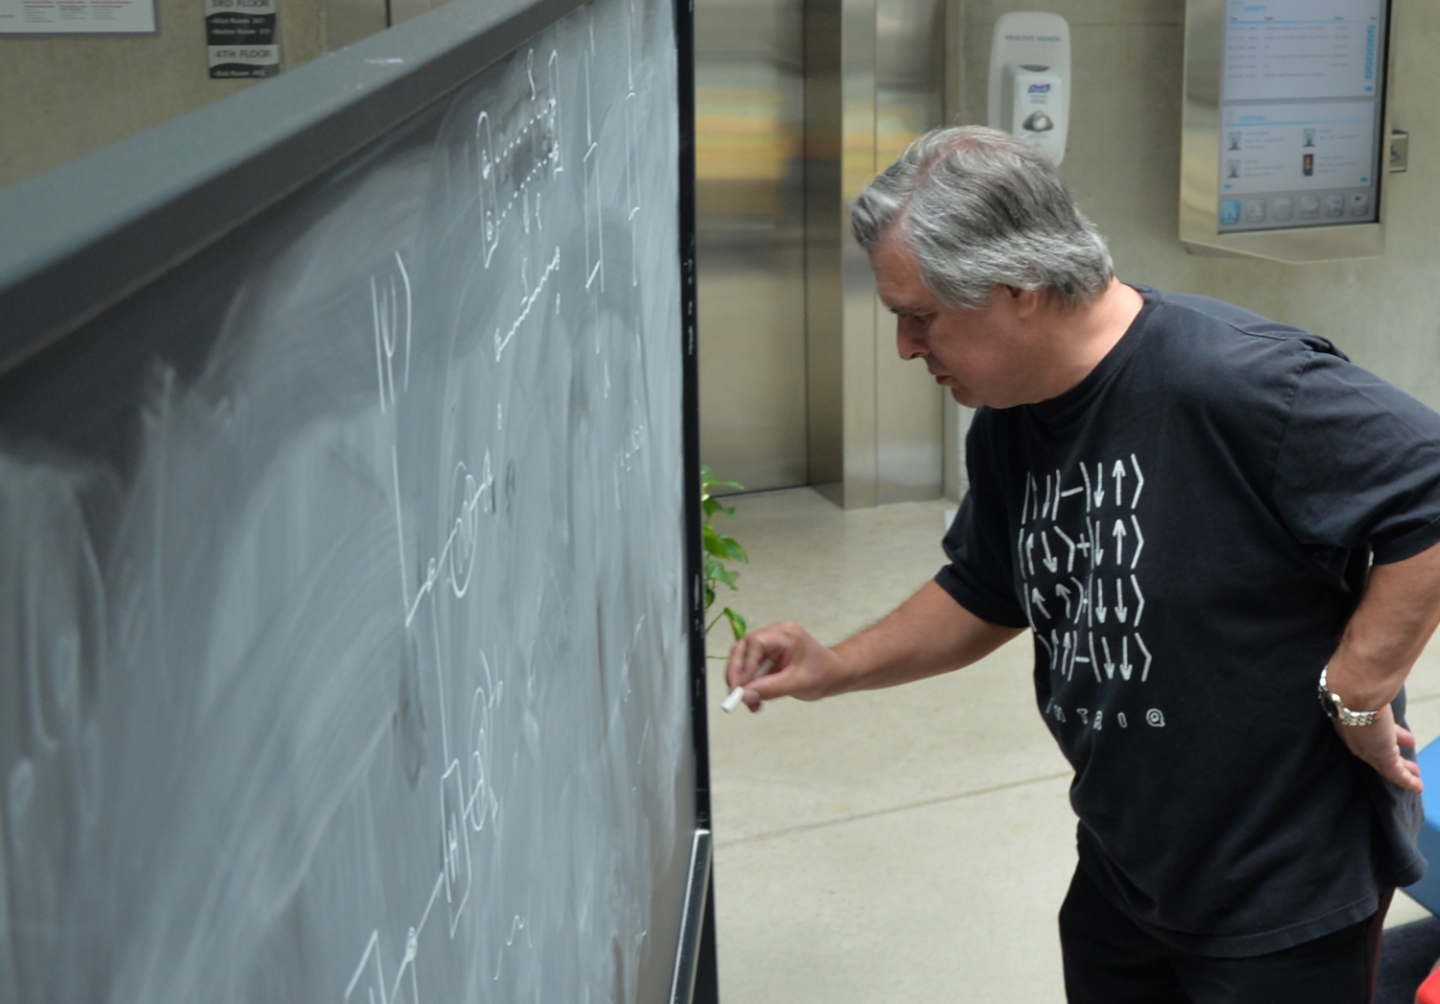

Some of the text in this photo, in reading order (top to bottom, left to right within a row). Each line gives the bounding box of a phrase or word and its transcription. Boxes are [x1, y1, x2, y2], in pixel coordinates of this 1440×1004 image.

[212, 0, 270, 8] 3RD FLOOR
[215, 50, 271, 58] 4TH FLOOR
